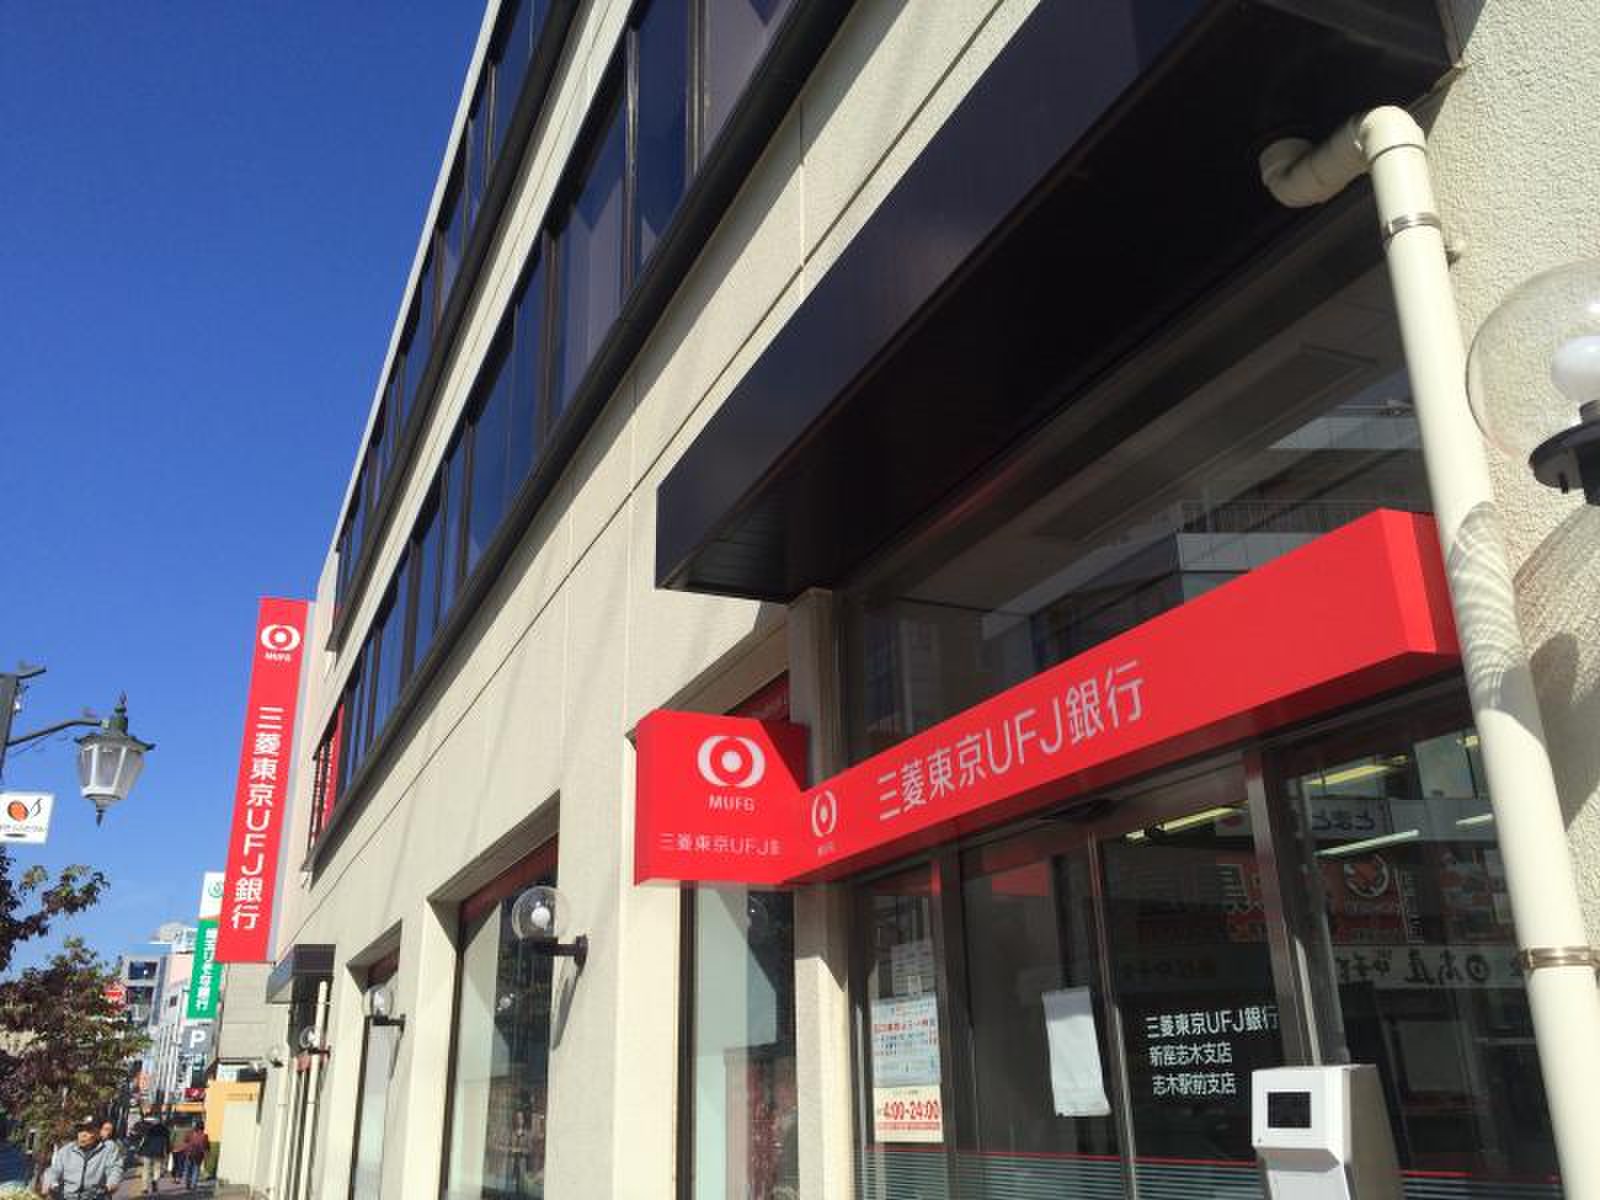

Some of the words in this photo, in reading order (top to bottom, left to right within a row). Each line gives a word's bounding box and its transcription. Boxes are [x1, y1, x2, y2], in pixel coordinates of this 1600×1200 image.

[878, 660, 1145, 822] 三菱東京UFJ銀行
[709, 795, 755, 812] MUFG
[231, 706, 284, 930] 三菱東京UFJ銀行
[1146, 1006, 1280, 1038] 三菱東京UFJ銀行
[190, 1030, 206, 1048] P
[1149, 1042, 1233, 1067] 新座志木支店
[1152, 1072, 1237, 1095] 志木駅前支店
